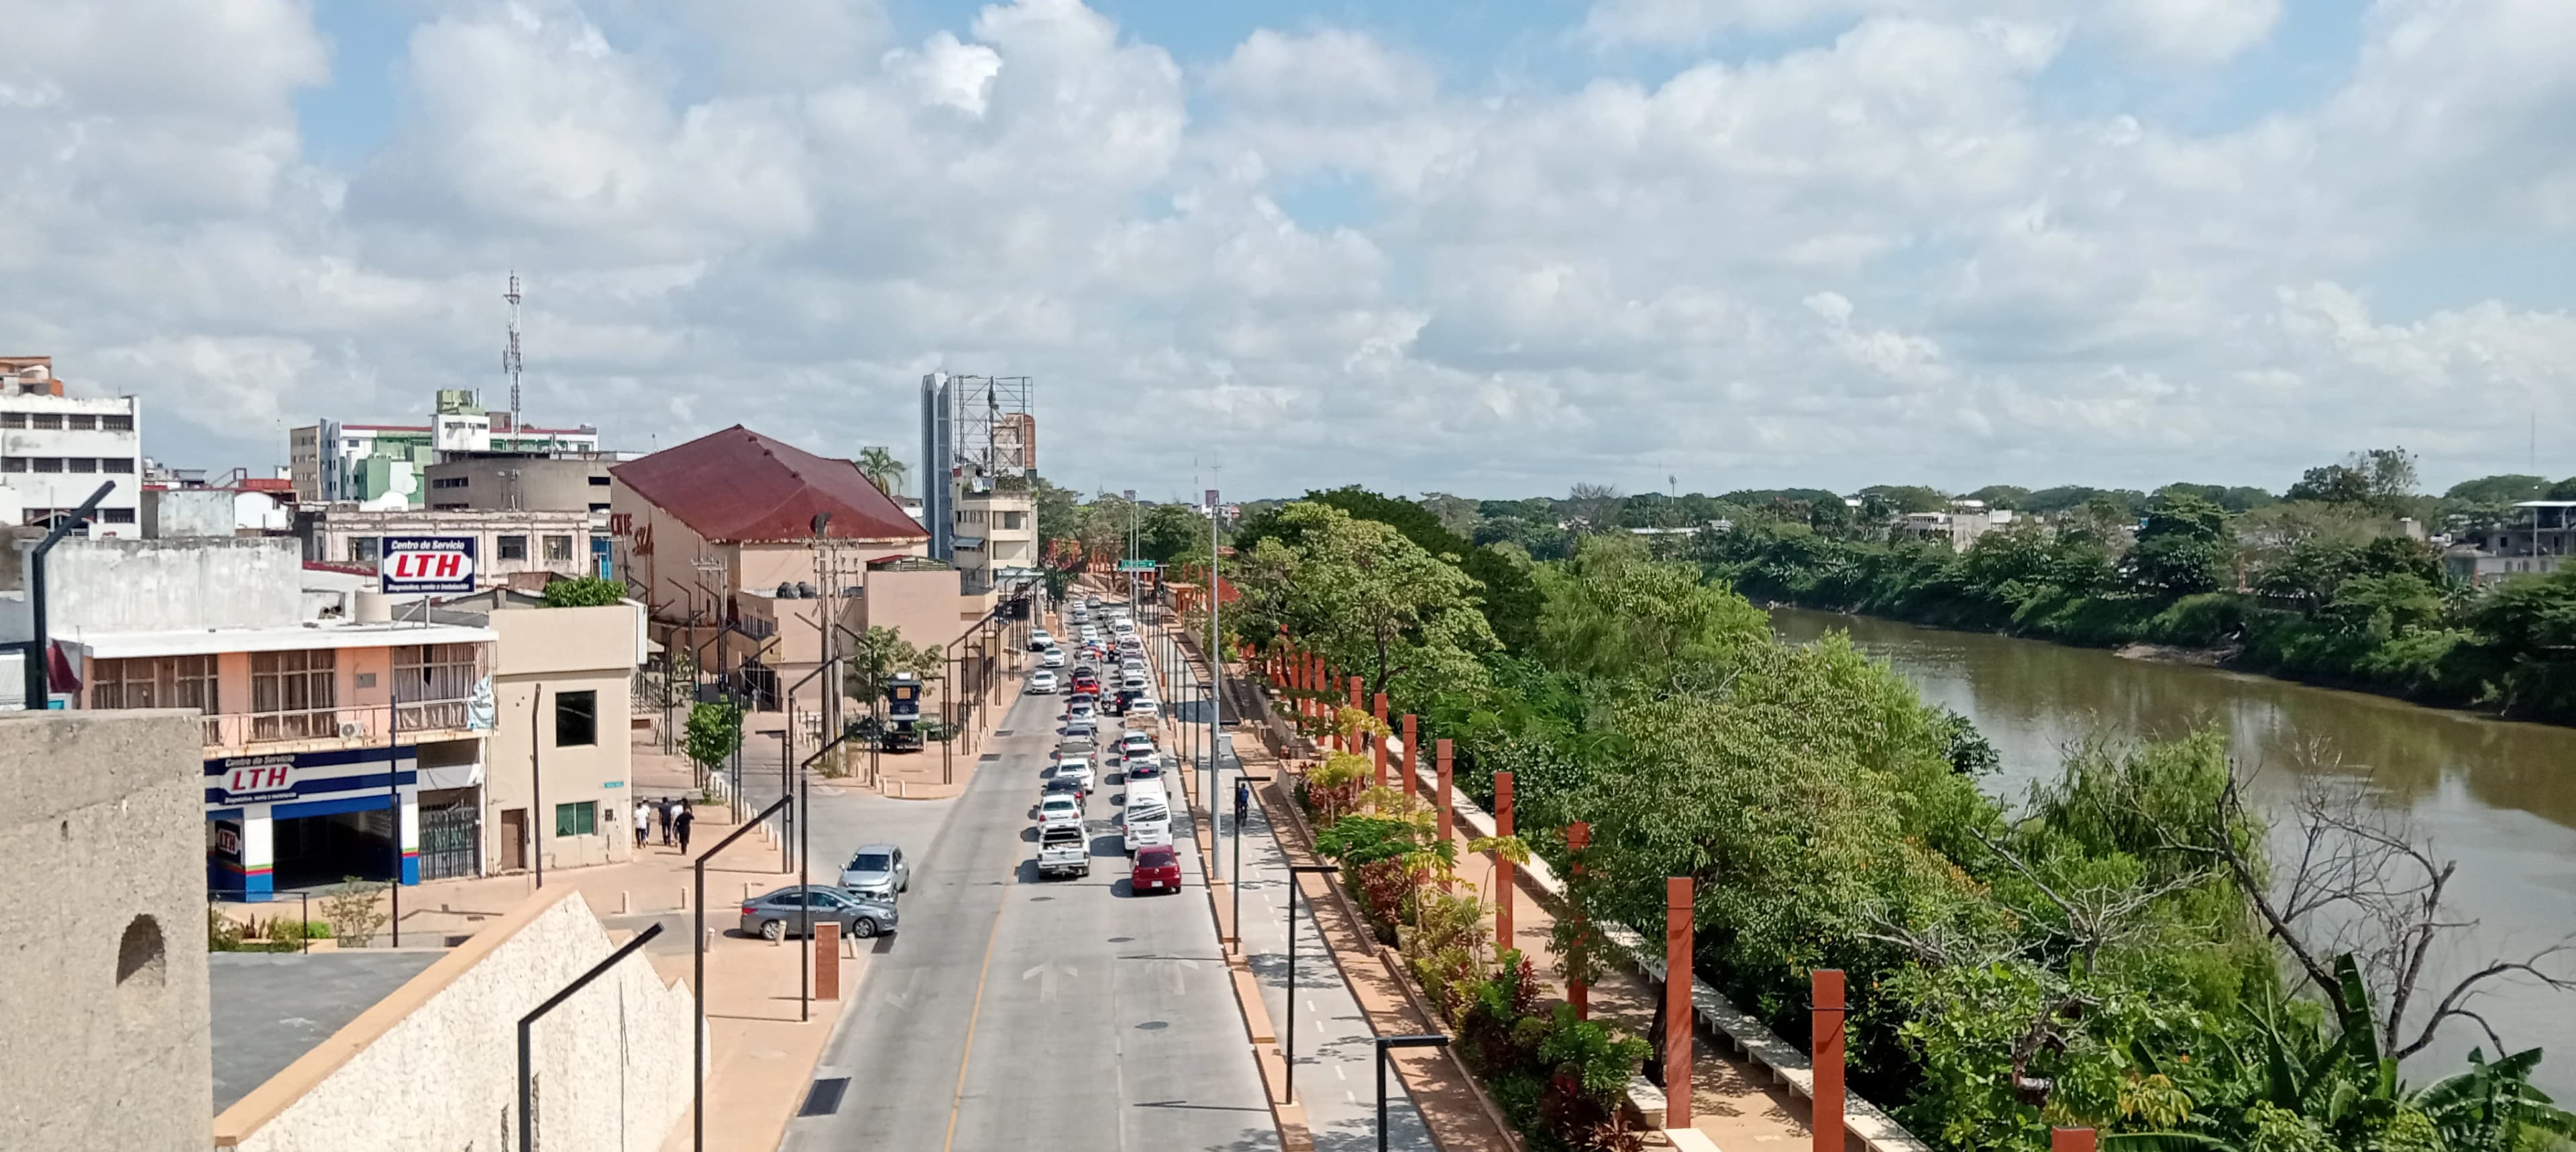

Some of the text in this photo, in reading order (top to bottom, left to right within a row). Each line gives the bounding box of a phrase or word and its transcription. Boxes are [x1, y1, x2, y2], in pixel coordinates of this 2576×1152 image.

[391, 539, 465, 549] Centro de Servicio
[395, 554, 462, 578] LTH
[225, 754, 295, 768] Centro de Servicio
[232, 766, 288, 790] LTH
